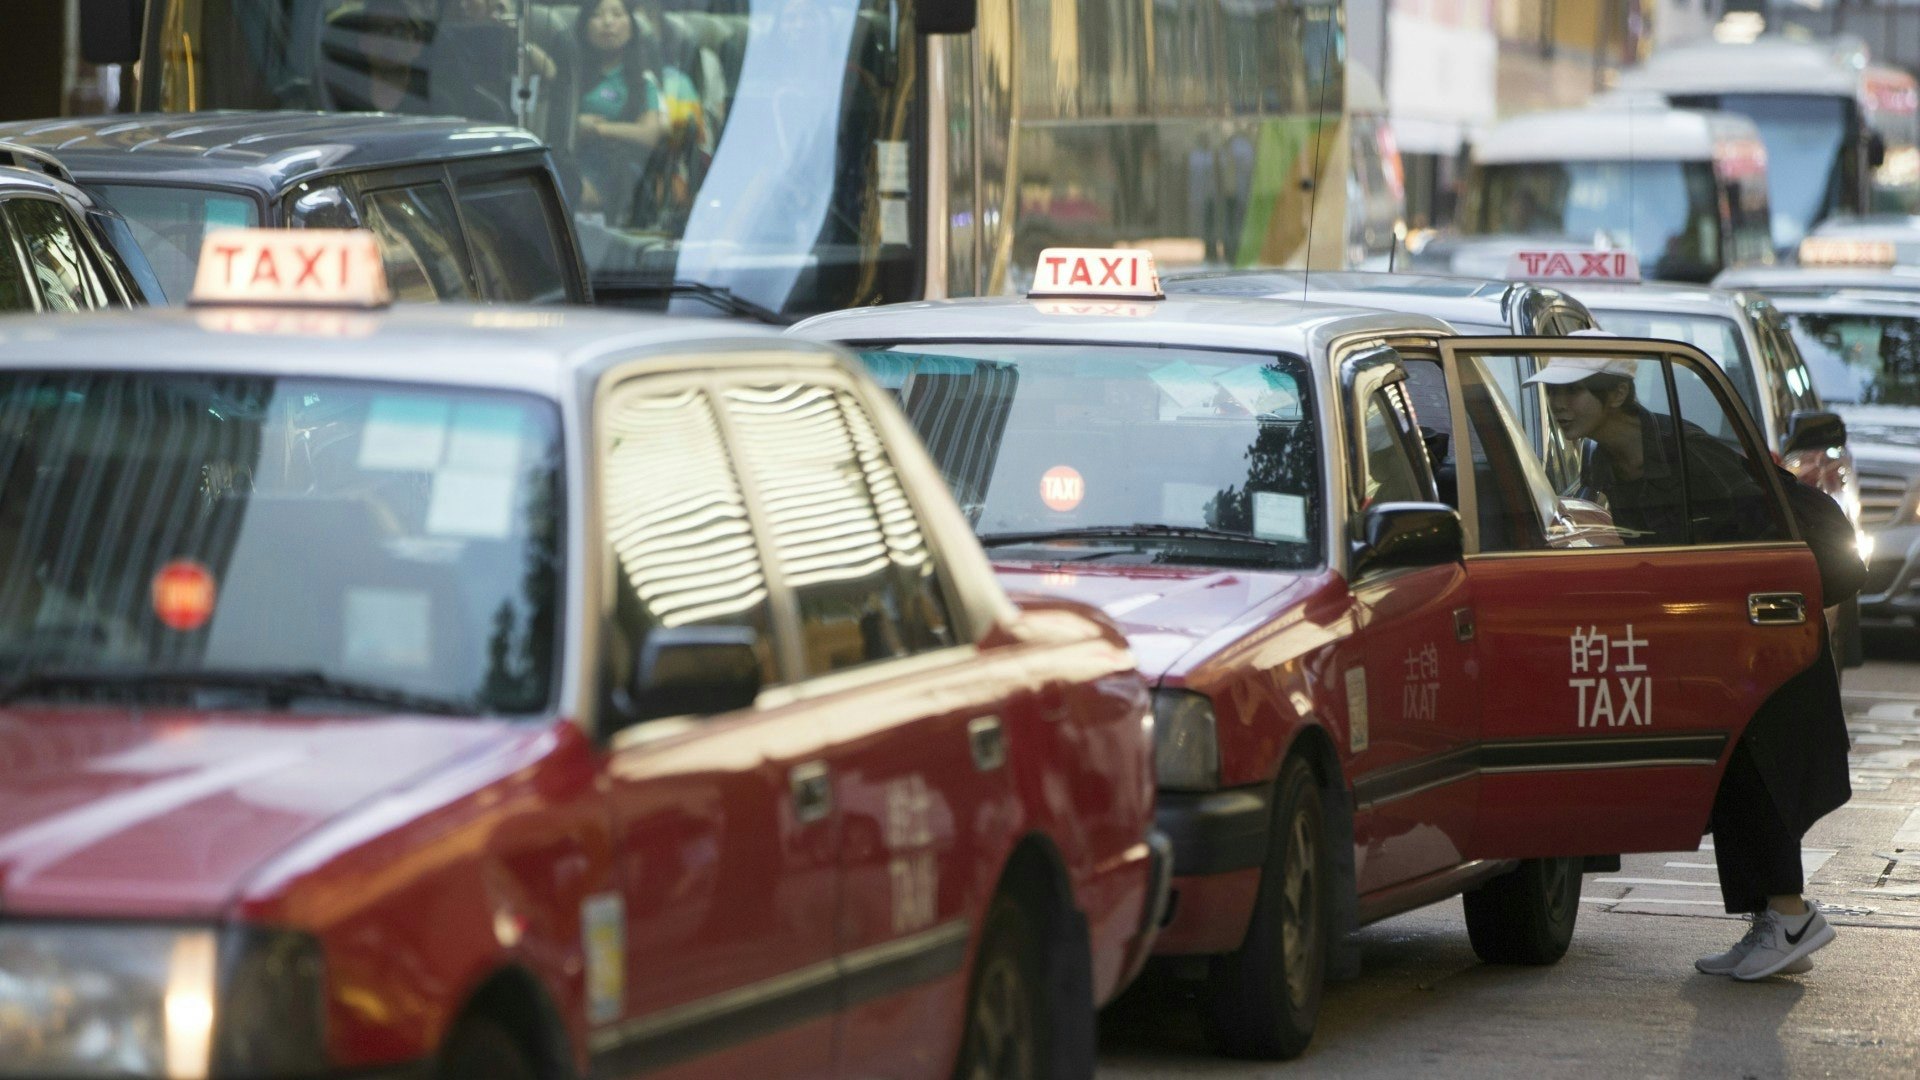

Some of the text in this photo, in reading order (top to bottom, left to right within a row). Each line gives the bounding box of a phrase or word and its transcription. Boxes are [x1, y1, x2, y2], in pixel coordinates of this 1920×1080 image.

[214, 244, 348, 287] TAXI
[1046, 258, 1137, 286] TAXI
[1519, 253, 1626, 277] TAXI
[1042, 476, 1081, 500] TAXI
[1570, 624, 1649, 673] 的士
[1568, 677, 1652, 728] TAXI
